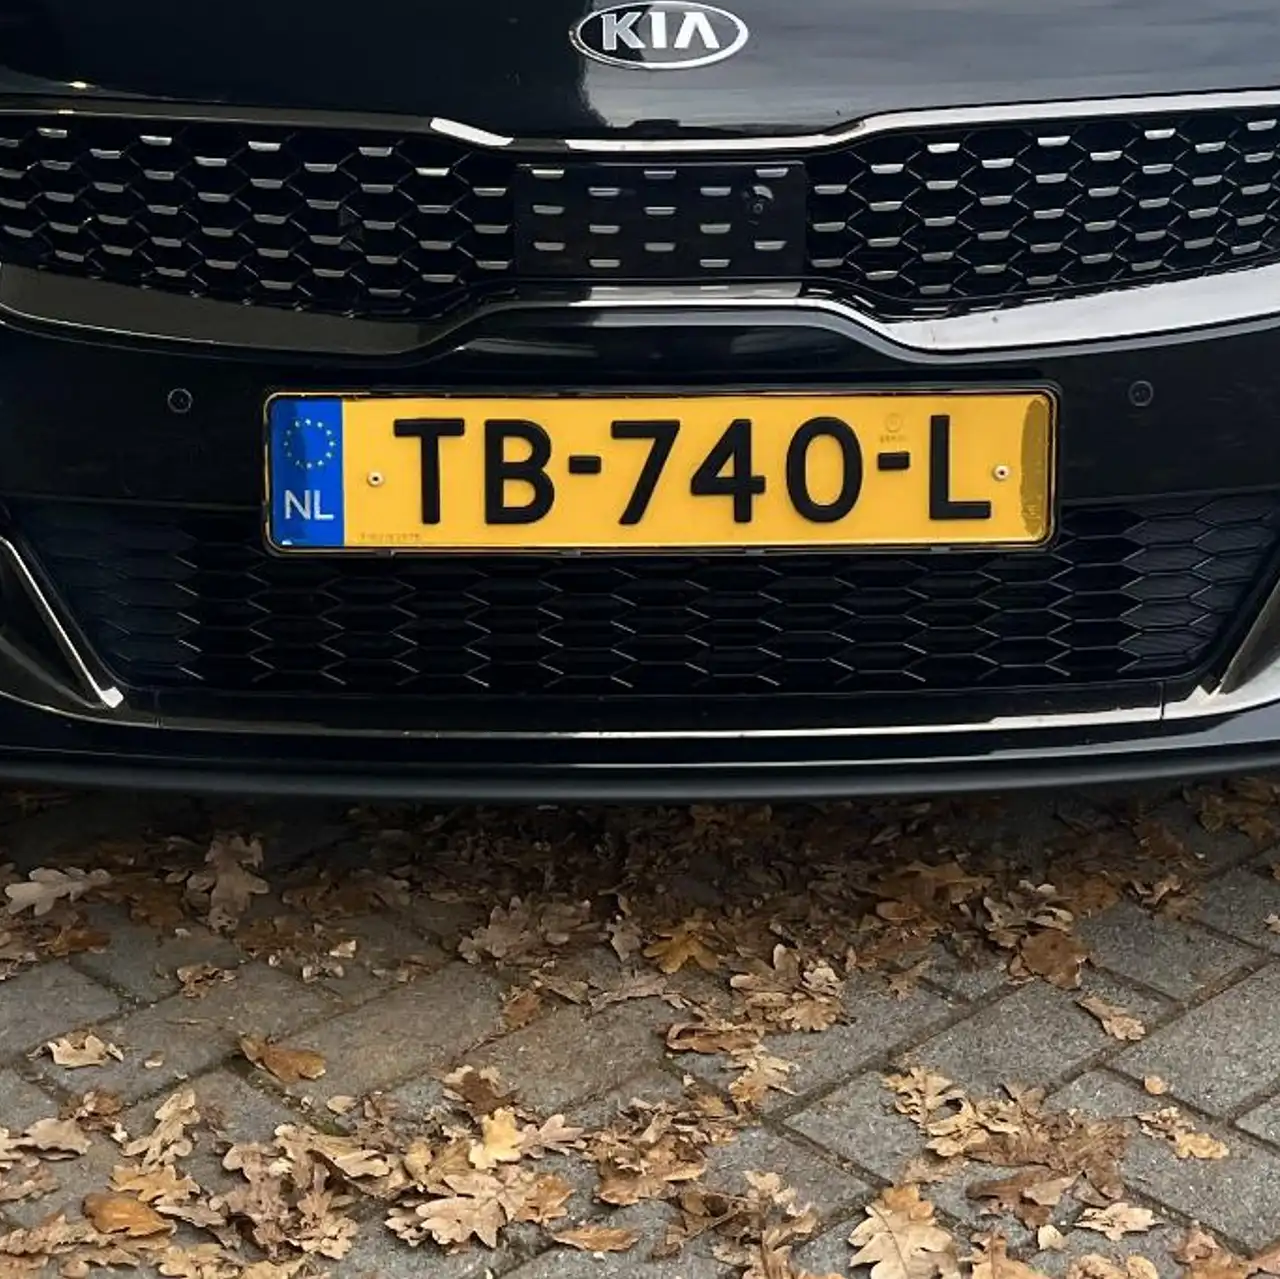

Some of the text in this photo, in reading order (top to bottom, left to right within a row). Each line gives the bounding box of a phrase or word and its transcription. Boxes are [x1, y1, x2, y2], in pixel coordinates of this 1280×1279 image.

[600, 11, 720, 51] KIA
[393, 414, 994, 525] TB-740-L
[284, 490, 335, 521] NL
